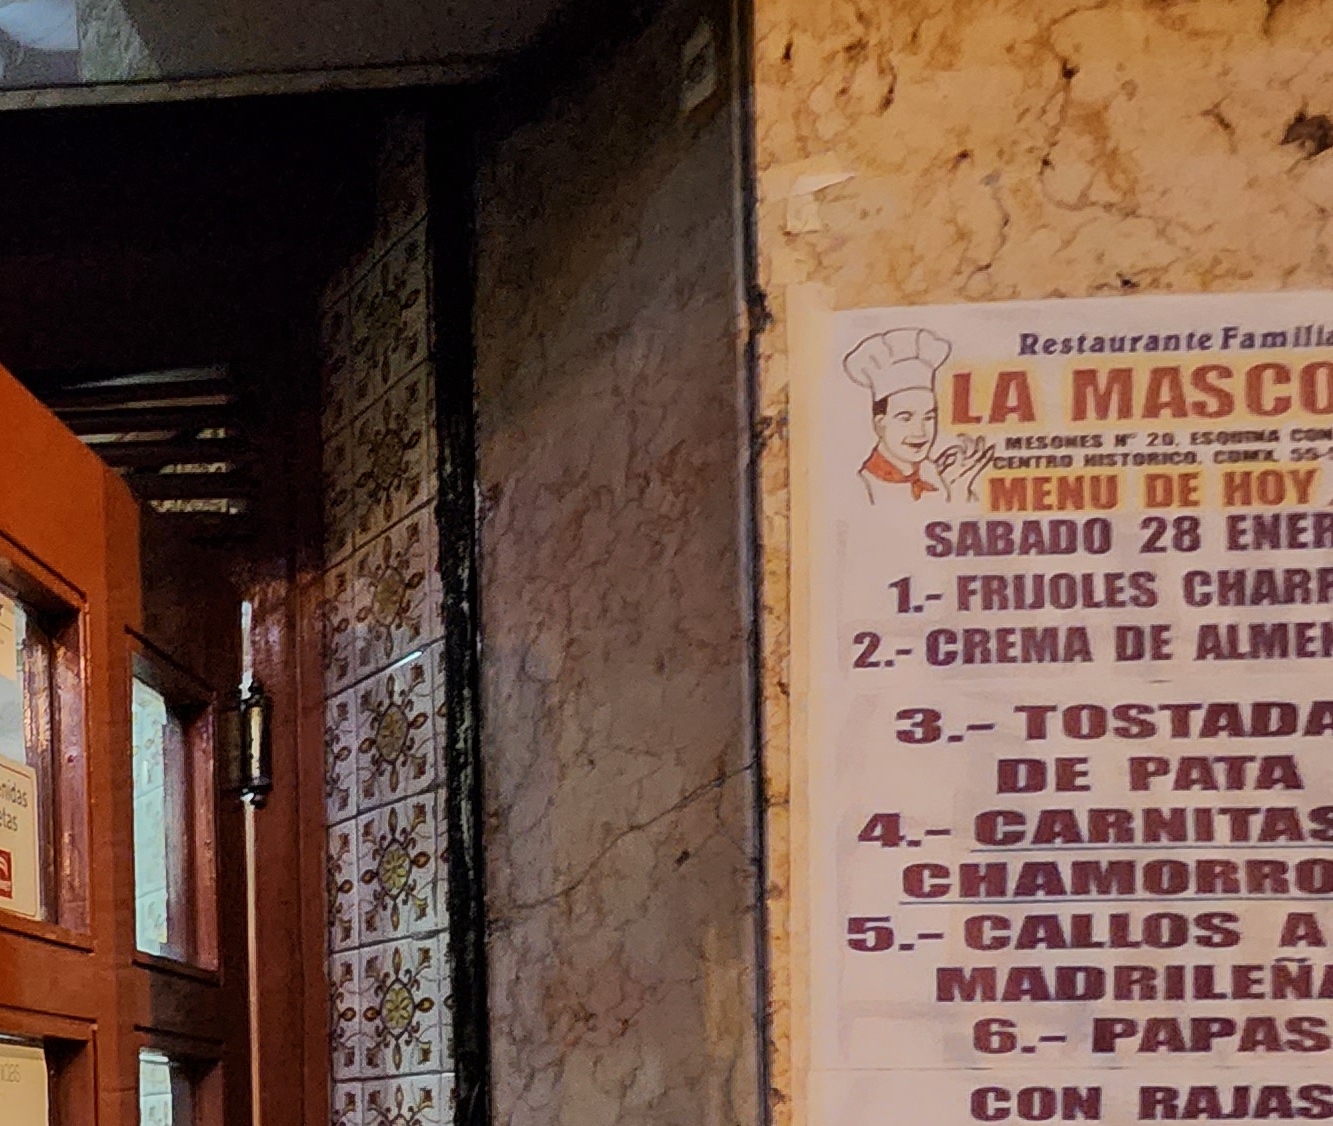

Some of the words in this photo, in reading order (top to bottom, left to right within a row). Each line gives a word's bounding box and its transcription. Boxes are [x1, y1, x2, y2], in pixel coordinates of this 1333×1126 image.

[1019, 329, 1212, 356] Restaurante
[951, 371, 1036, 425] LA
[1071, 361, 1333, 422] MASCO
[993, 454, 1073, 470] CENTRO
[989, 475, 1121, 511] MENU
[1144, 471, 1202, 509] DE
[1222, 469, 1319, 507] HOY
[925, 515, 1112, 557] SABADO
[1140, 514, 1201, 552] 28
[1225, 512, 1333, 551] ENER
[888, 575, 942, 614] 1.-
[956, 569, 1159, 613] FRIJOLES
[852, 631, 912, 669] 2.-
[925, 624, 1093, 667] CREMA
[1114, 623, 1173, 662] DE
[895, 708, 995, 745] 3.-
[1014, 701, 1333, 740] TOSTADA
[997, 756, 1091, 794] DE
[1128, 754, 1305, 792] PATA
[858, 812, 951, 848] 4.-
[902, 858, 1333, 898] CHAMORRO
[846, 916, 945, 952] 5.-
[964, 911, 1241, 951] CALLOS
[1279, 911, 1327, 948] A
[972, 1016, 1067, 1055] 6.-
[1090, 1016, 1333, 1054] PAPAS
[970, 1085, 1102, 1122] CON
[1138, 1084, 1333, 1121] RAJAS
